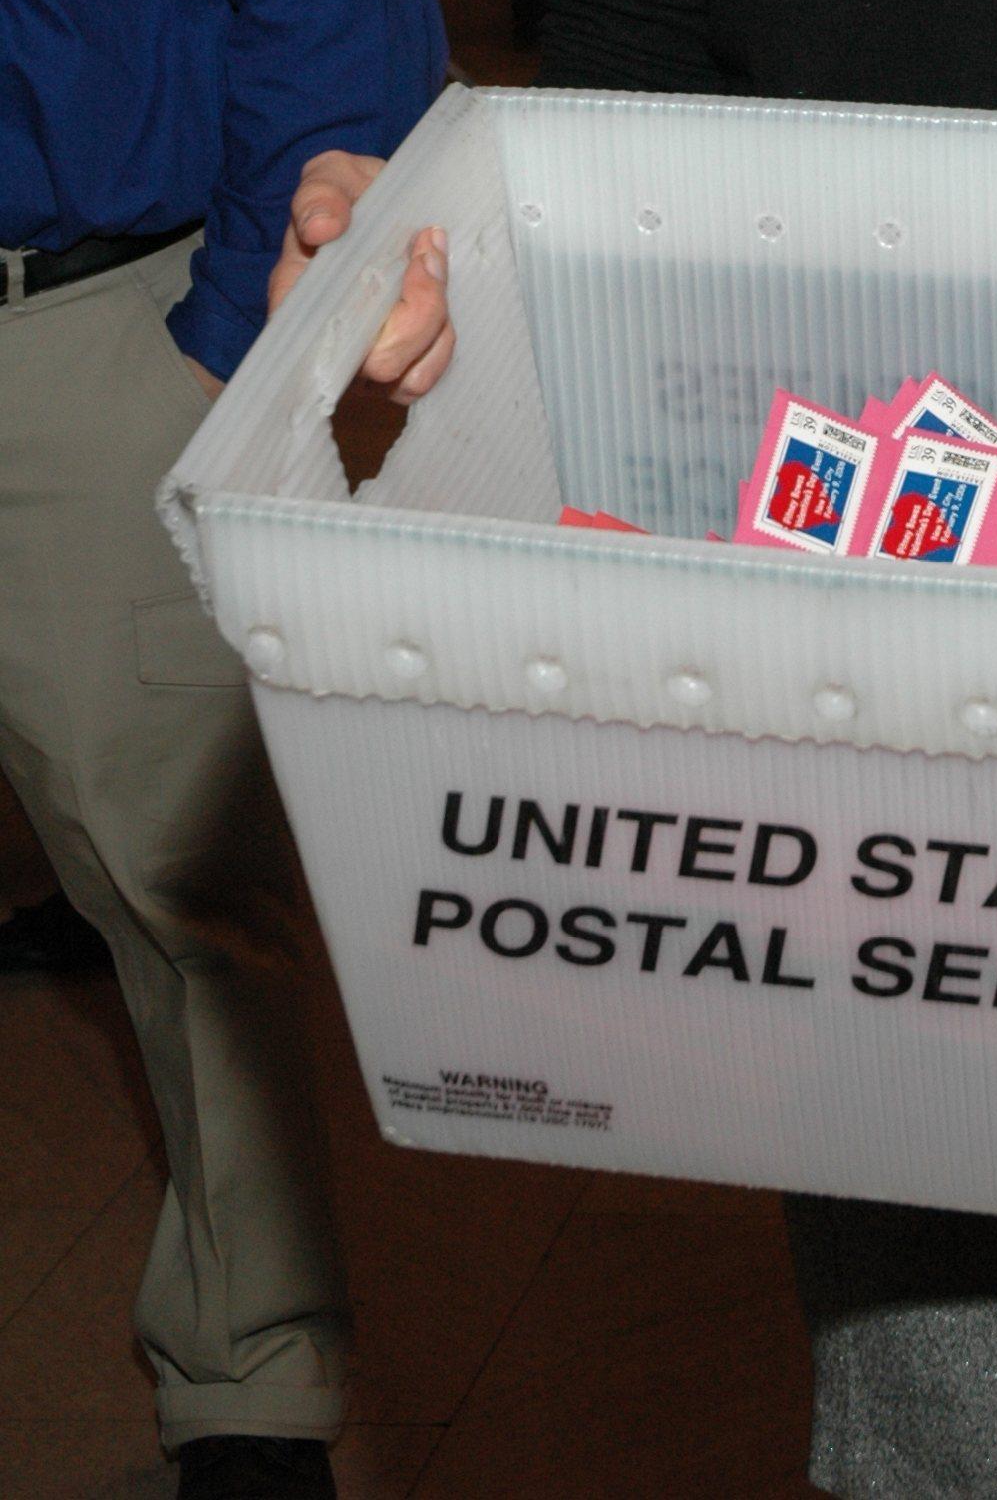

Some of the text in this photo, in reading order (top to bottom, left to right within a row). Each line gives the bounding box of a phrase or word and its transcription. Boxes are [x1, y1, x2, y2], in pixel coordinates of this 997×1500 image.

[942, 396, 957, 414] 39
[803, 416, 818, 434] 39
[811, 450, 824, 472] Event
[921, 447, 937, 464] 39
[790, 474, 806, 498] Bowes
[806, 472, 819, 489] Day
[814, 466, 834, 515] New York City
[928, 478, 942, 500] Event
[823, 490, 840, 519] February
[922, 500, 937, 517] Day
[930, 492, 956, 542] New York City
[896, 504, 921, 554] Pitney Bowes
[940, 513, 960, 543] February
[441, 790, 818, 888] UNITED
[412, 888, 816, 988] POSTAL
[438, 1069, 549, 1095] WARNING
